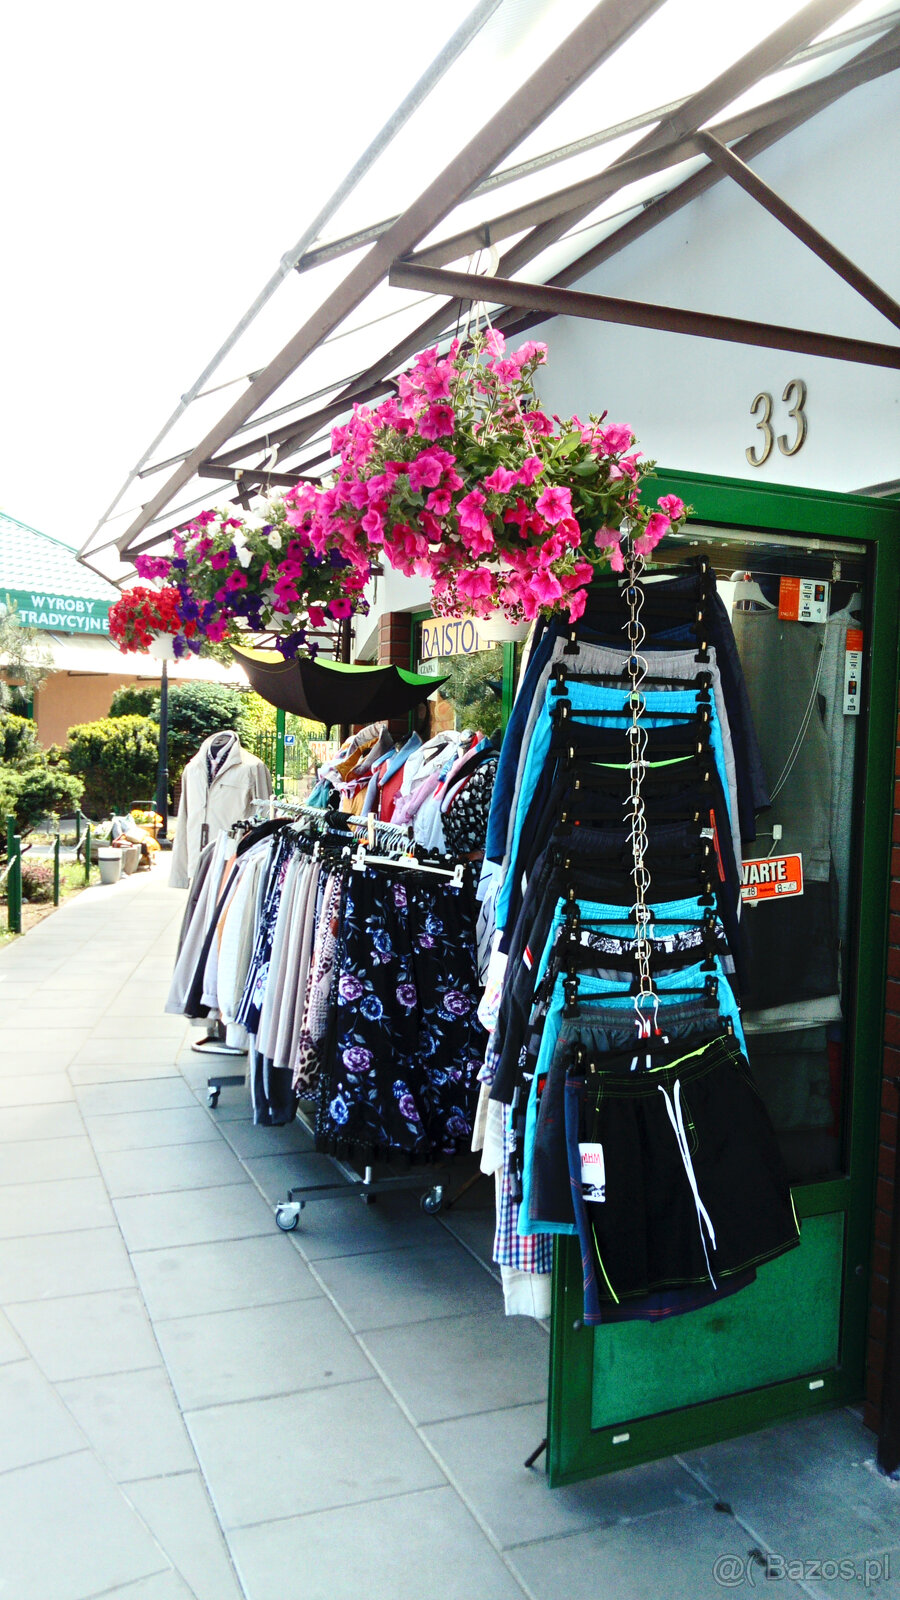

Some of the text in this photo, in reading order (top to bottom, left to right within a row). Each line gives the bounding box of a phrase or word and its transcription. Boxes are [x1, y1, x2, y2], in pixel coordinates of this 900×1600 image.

[745, 379, 807, 467] 33
[31, 595, 95, 613] WYROBY
[19, 610, 110, 631] TRADYCYJNE
